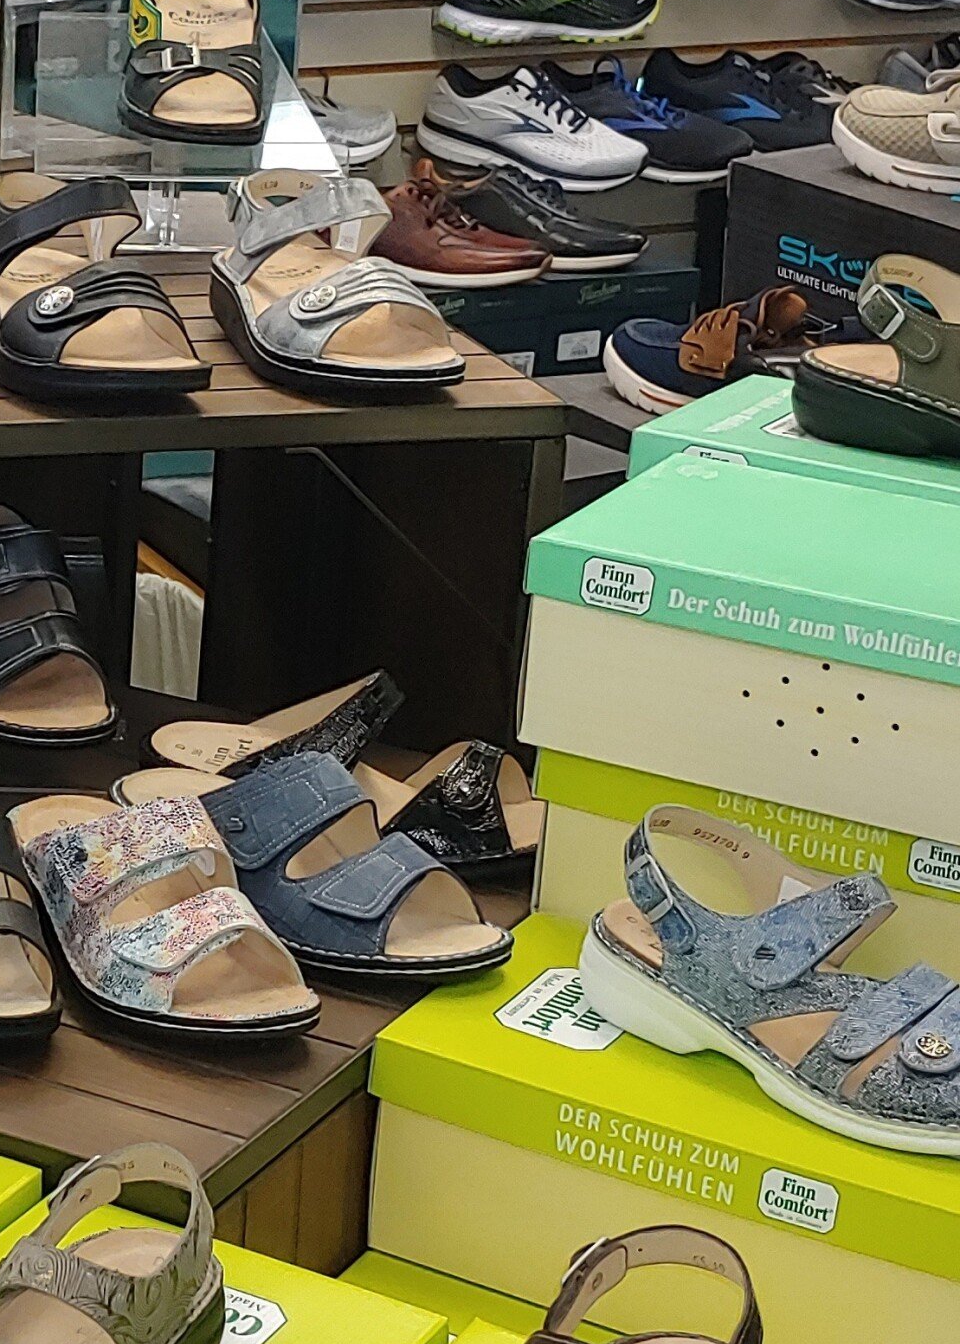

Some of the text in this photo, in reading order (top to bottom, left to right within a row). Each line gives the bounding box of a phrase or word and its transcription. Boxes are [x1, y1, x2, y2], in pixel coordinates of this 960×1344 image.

[778, 266, 820, 290] ULTIMATE
[600, 564, 635, 585] Finn
[585, 579, 646, 605] Comfort
[669, 588, 960, 665] Der Schuh zum Wohlfühle
[718, 791, 889, 847] DER SCHUH ZUM
[914, 858, 960, 881] Comfo
[559, 1103, 740, 1174] DER SCHUH ZUM
[556, 1130, 734, 1206] WOHLFÜHLEN
[781, 1177, 816, 1201] Finn
[764, 1190, 829, 1222] Comfort
